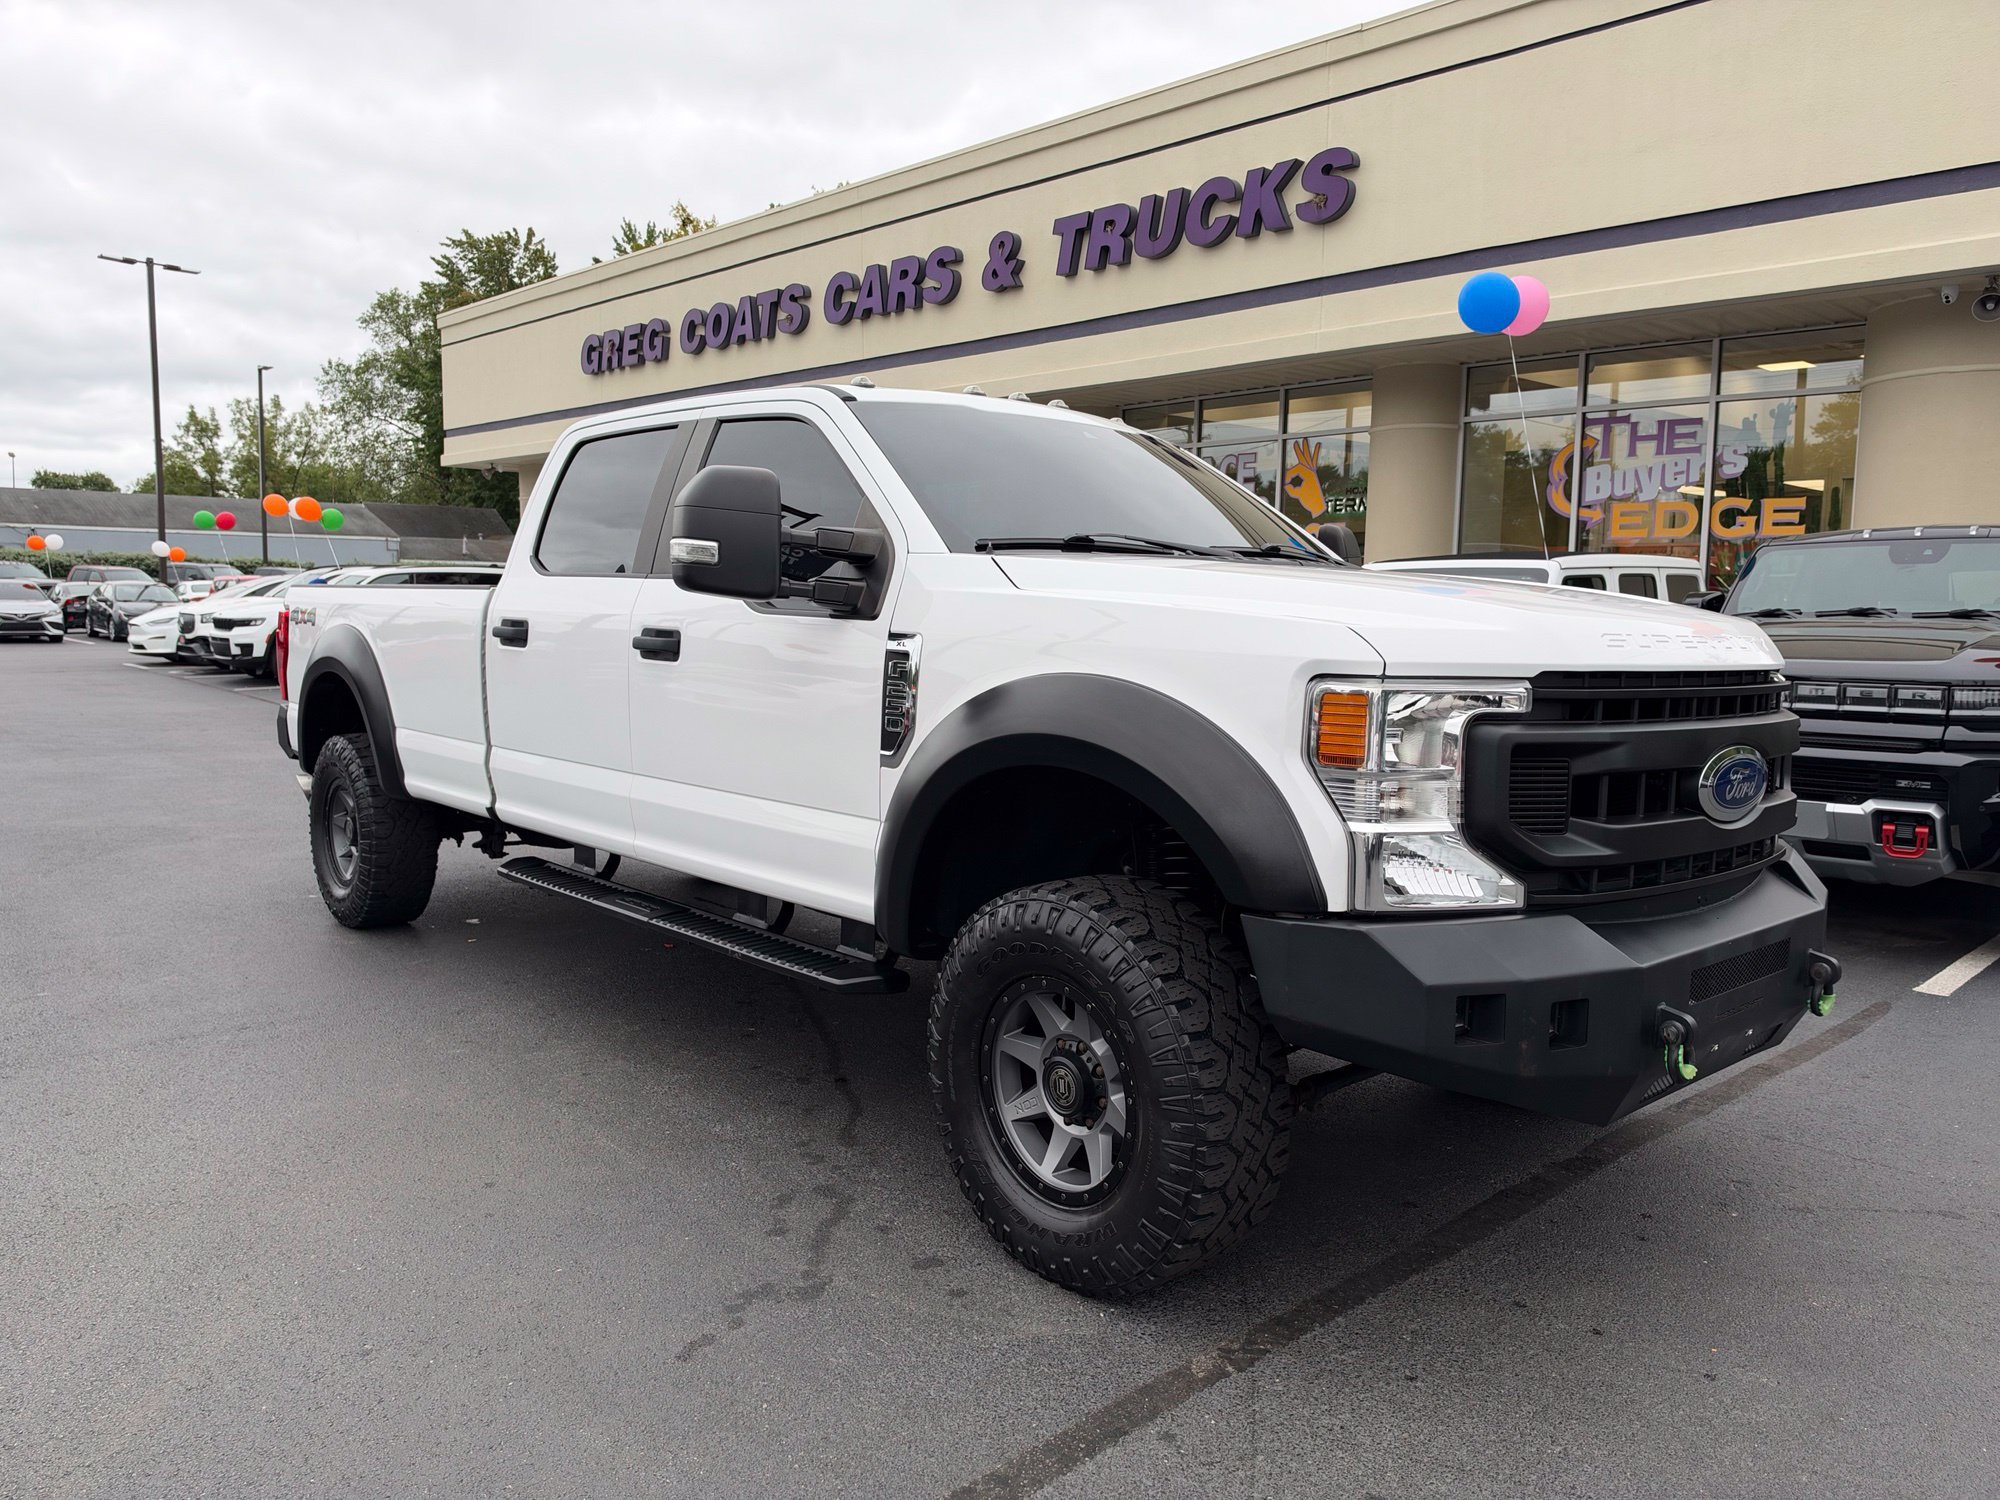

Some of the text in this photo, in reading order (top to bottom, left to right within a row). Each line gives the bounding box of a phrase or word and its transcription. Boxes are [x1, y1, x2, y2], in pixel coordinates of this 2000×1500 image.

[581, 147, 1360, 375] GREG COATS CARS & TRUCKS
[1585, 414, 1703, 460] THE
[1609, 496, 1808, 540] EDGE
[1725, 767, 1760, 800] Ford
